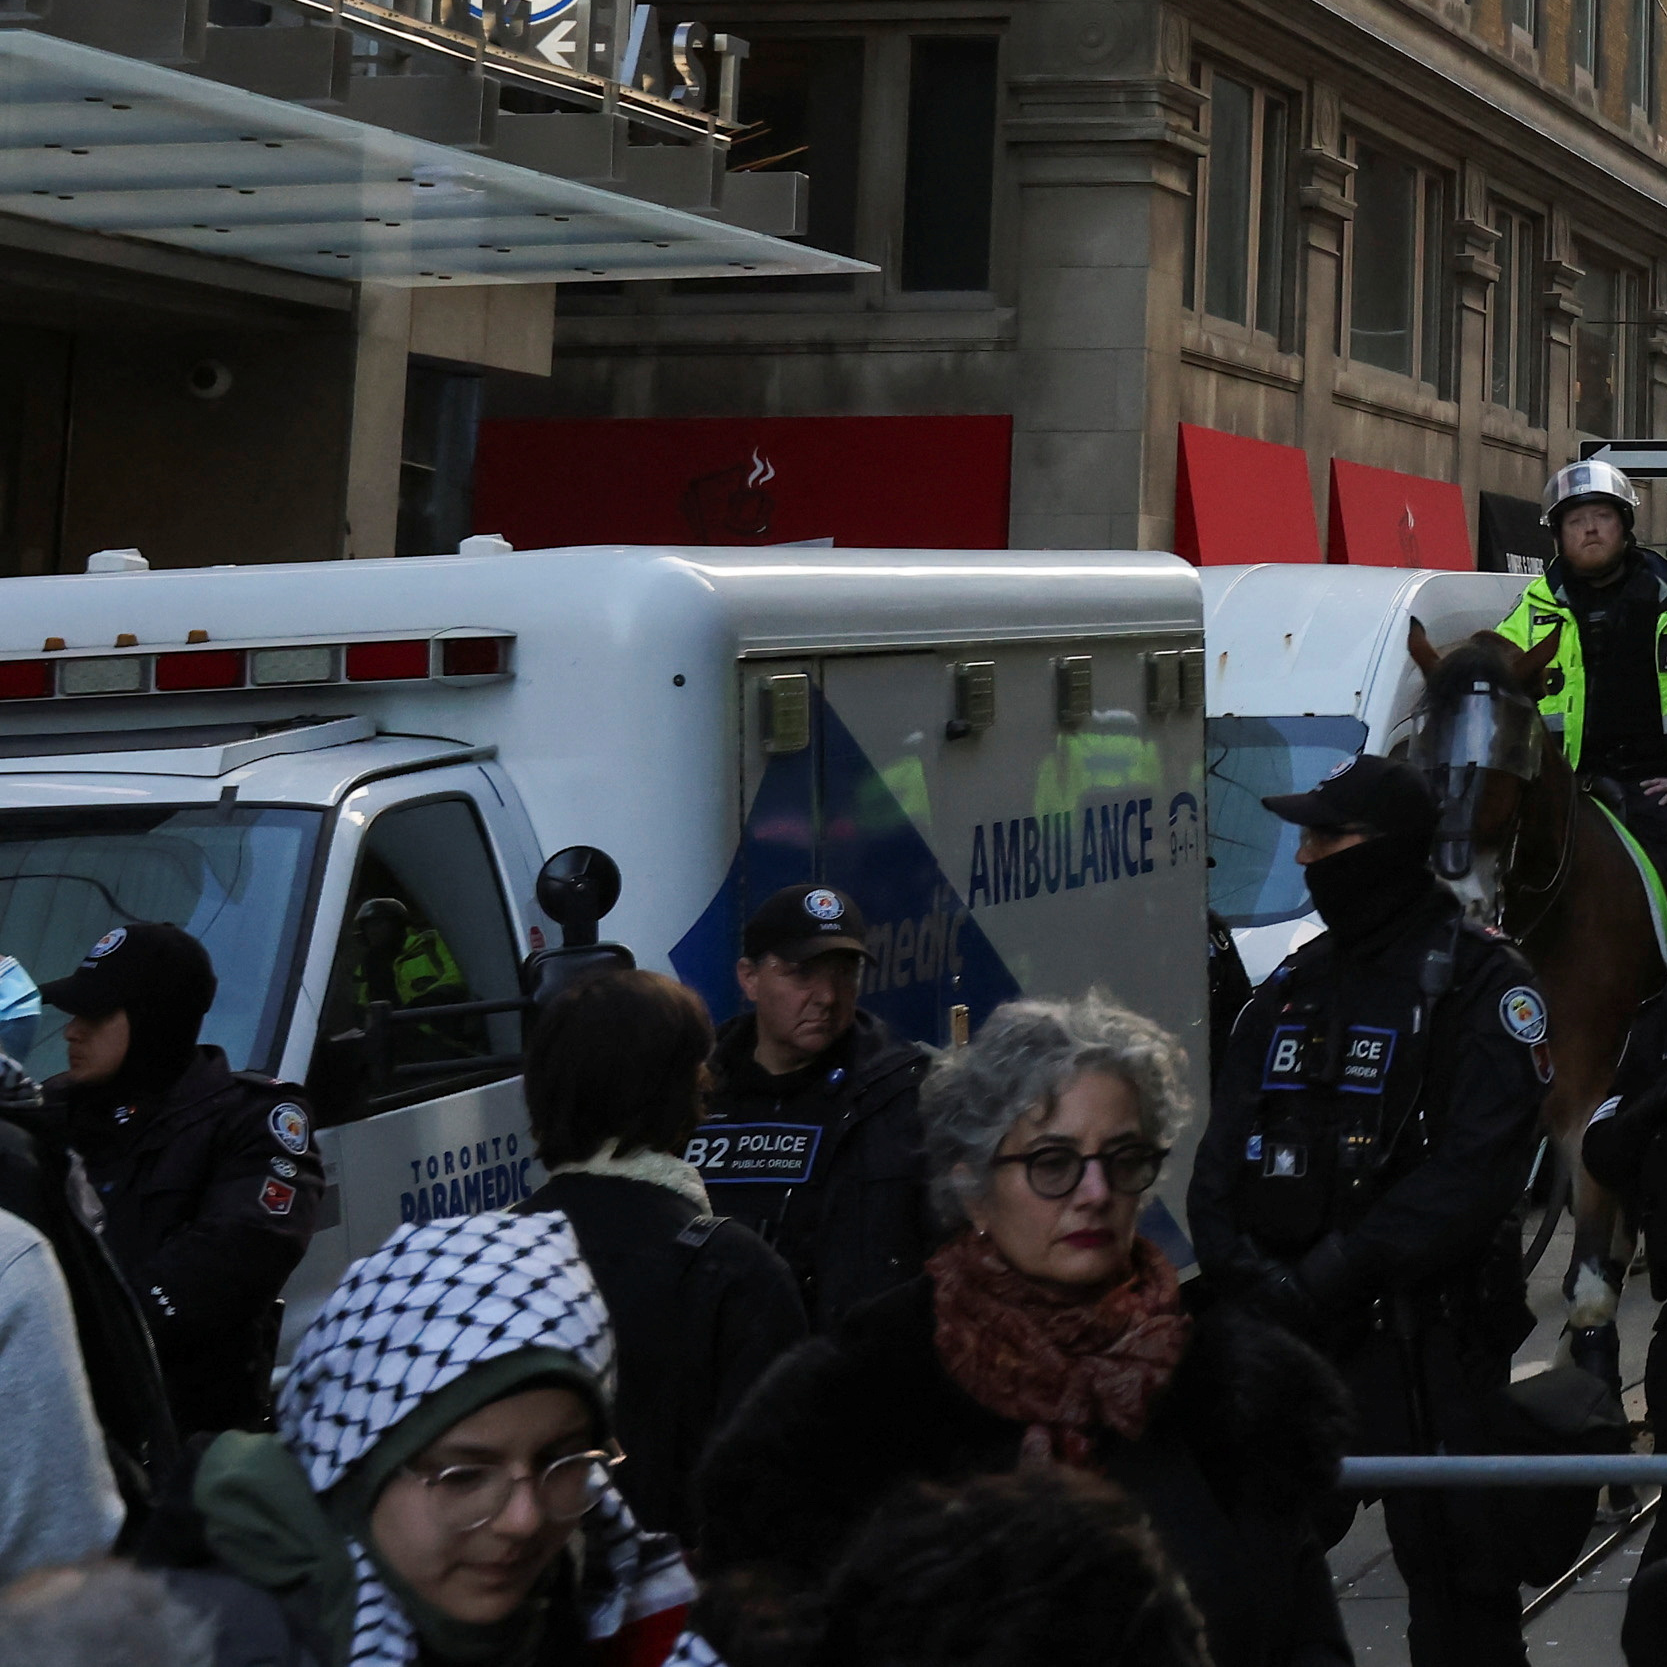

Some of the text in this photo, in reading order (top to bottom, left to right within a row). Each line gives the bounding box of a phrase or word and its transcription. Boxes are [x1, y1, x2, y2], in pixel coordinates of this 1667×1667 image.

[969, 797, 1154, 909] AMBULANCE
[1344, 1065, 1379, 1079] ORDER
[411, 1133, 518, 1184] TORONTO
[683, 1137, 731, 1169] B2
[735, 1134, 808, 1153] POLICE
[731, 1158, 803, 1169] PUBLIC ORDER
[401, 1156, 533, 1224] PARAMEDIC
